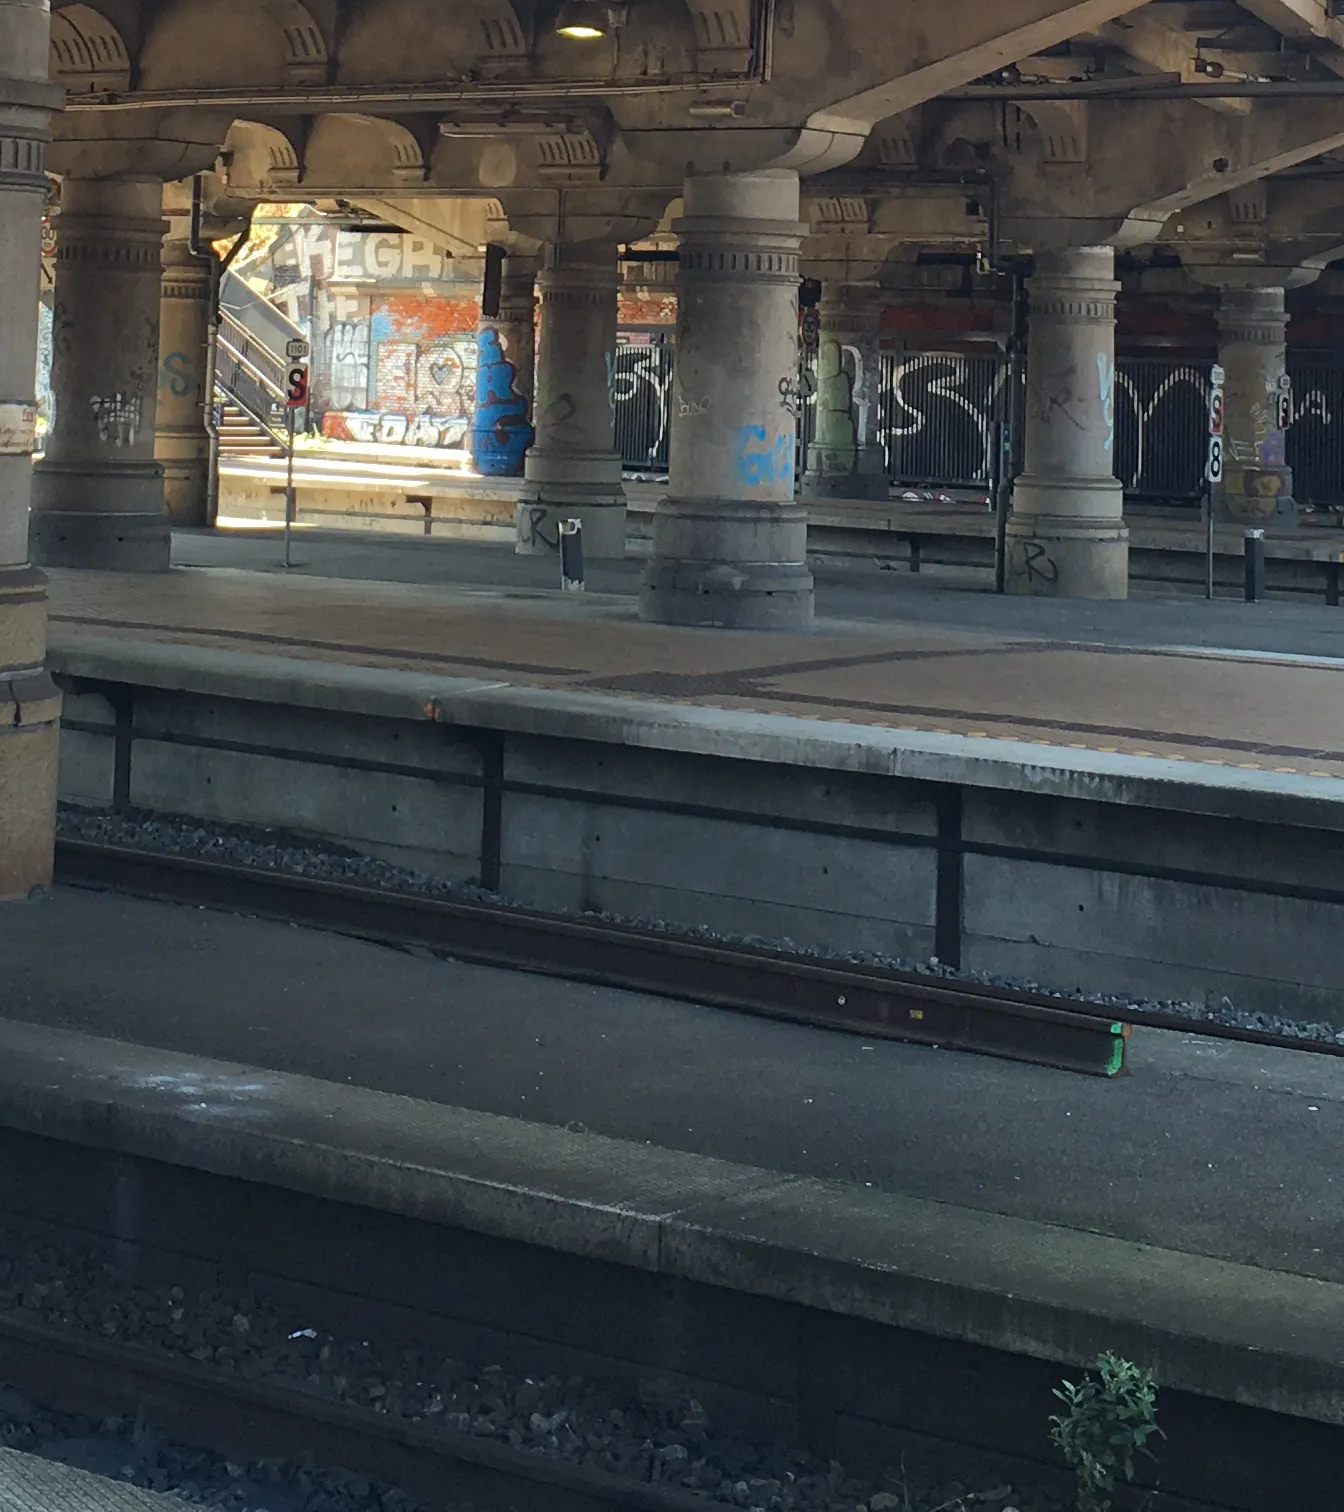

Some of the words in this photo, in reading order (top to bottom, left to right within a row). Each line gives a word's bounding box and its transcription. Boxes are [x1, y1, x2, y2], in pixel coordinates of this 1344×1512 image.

[291, 344, 307, 354] 1101
[287, 368, 305, 401] S
[1212, 394, 1223, 428] S
[1210, 441, 1221, 477] 8
